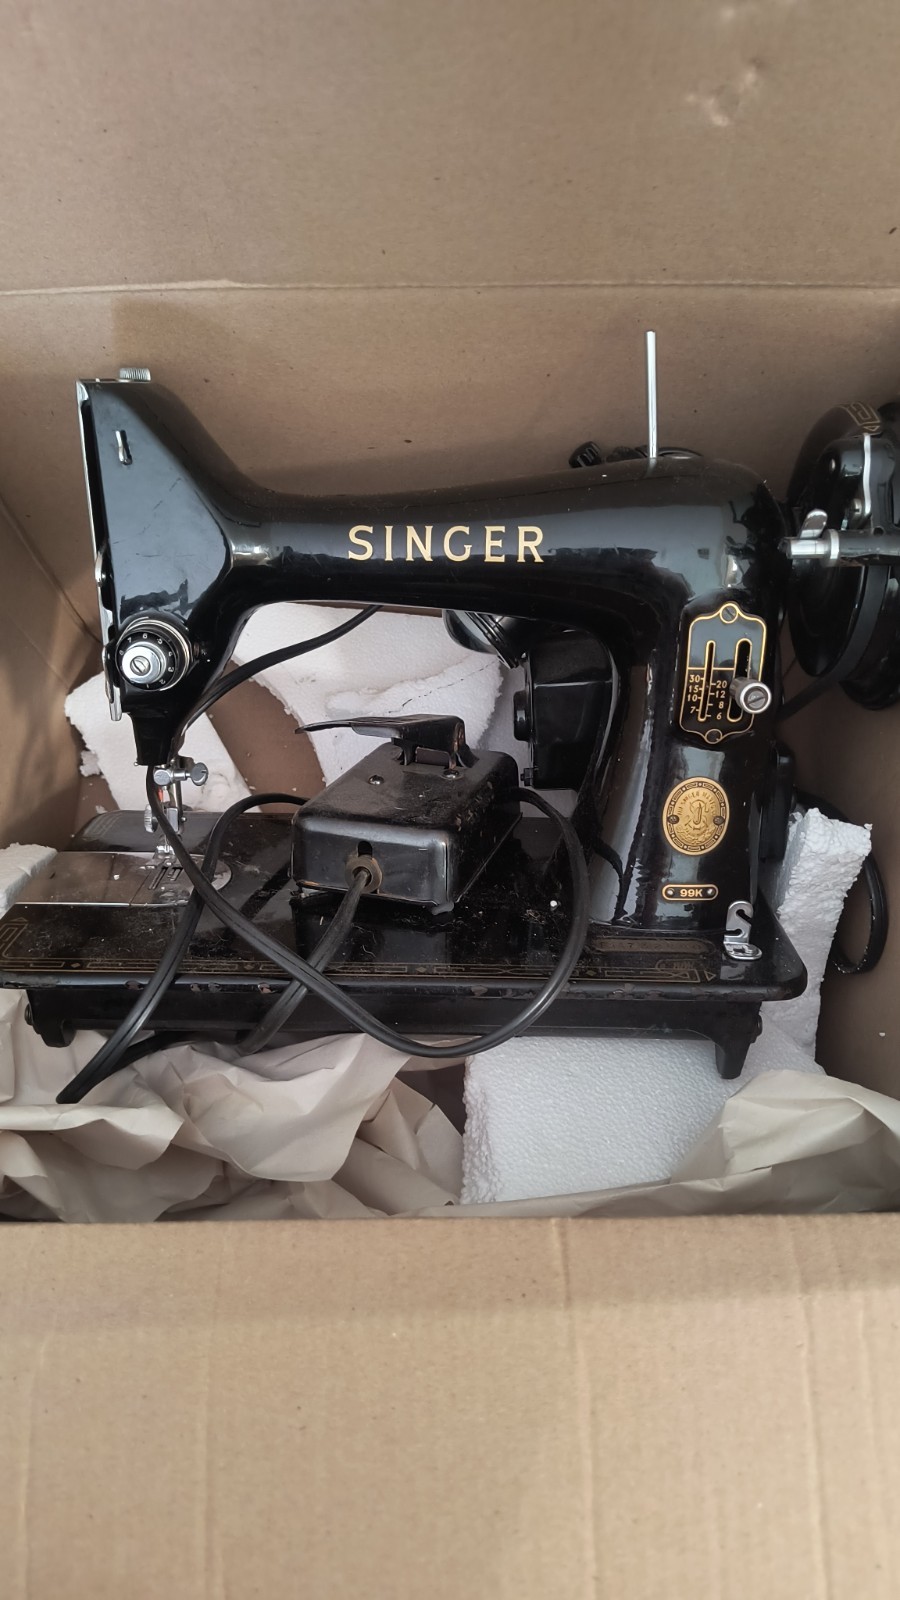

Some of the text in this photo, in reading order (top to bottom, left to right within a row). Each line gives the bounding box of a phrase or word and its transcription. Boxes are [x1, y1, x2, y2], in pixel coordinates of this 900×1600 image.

[348, 525, 544, 563] SINGER
[689, 674, 700, 683] 30
[688, 685, 699, 693] 15
[716, 680, 728, 689] 20
[687, 694, 698, 702] 10
[715, 690, 726, 699] 12
[718, 701, 724, 709] 8
[690, 706, 695, 714] 7
[716, 711, 722, 720] 6
[680, 888, 703, 897] 99K
